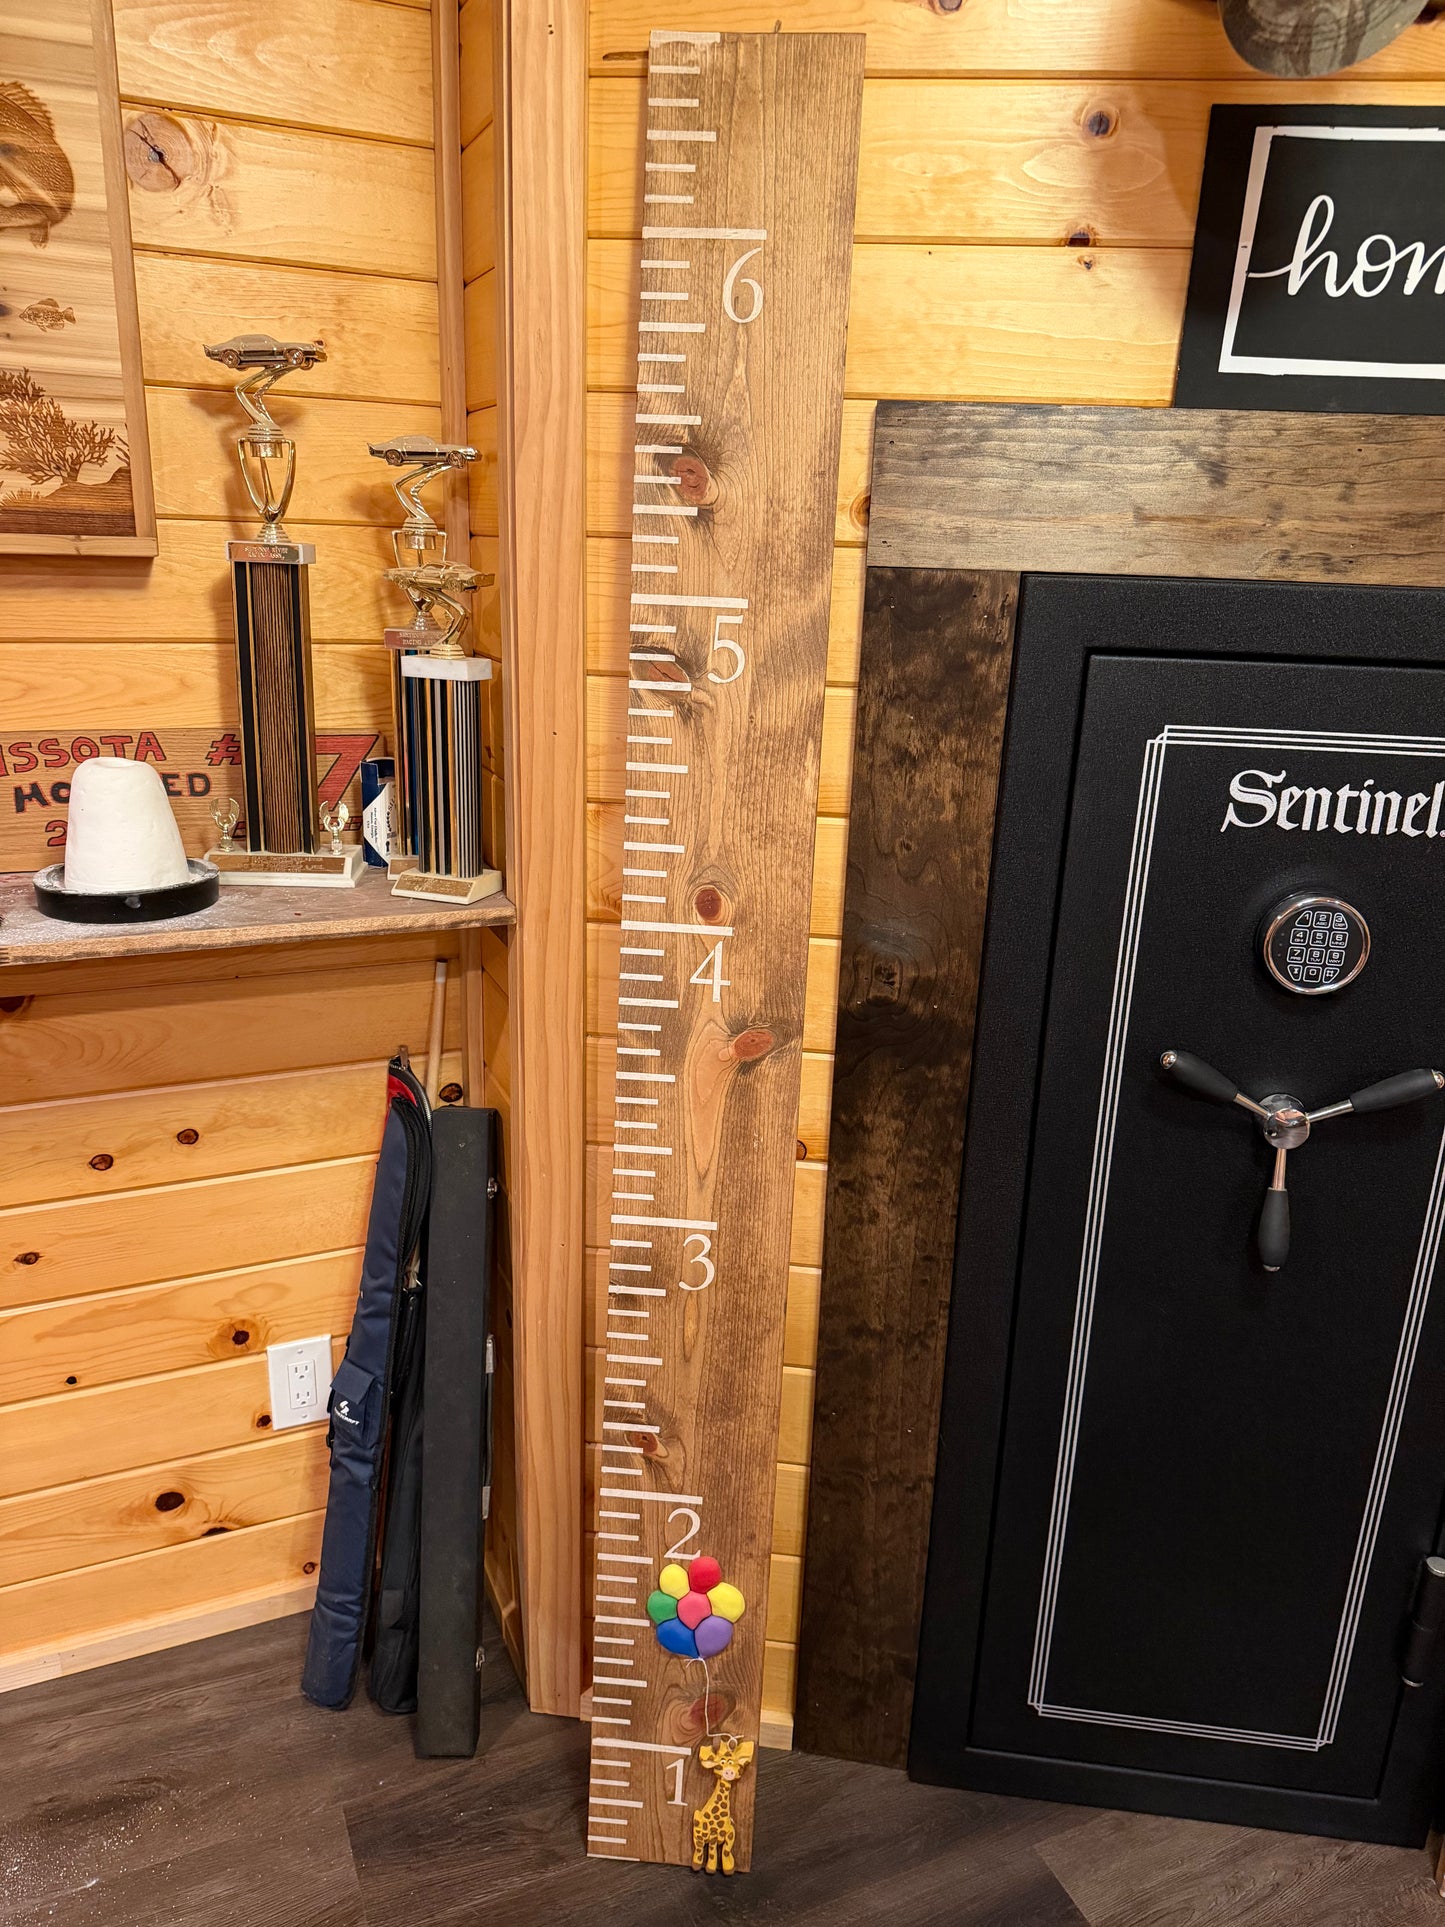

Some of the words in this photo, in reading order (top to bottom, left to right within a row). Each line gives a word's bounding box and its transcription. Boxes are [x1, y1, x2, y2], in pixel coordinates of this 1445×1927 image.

[722, 247, 764, 323] 6
[707, 614, 746, 684] 5
[1220, 769, 1445, 838] Sentinel
[690, 941, 731, 1002] 4
[678, 1233, 716, 1291] 3
[663, 1507, 701, 1561] 2
[665, 1757, 689, 1807] 1
